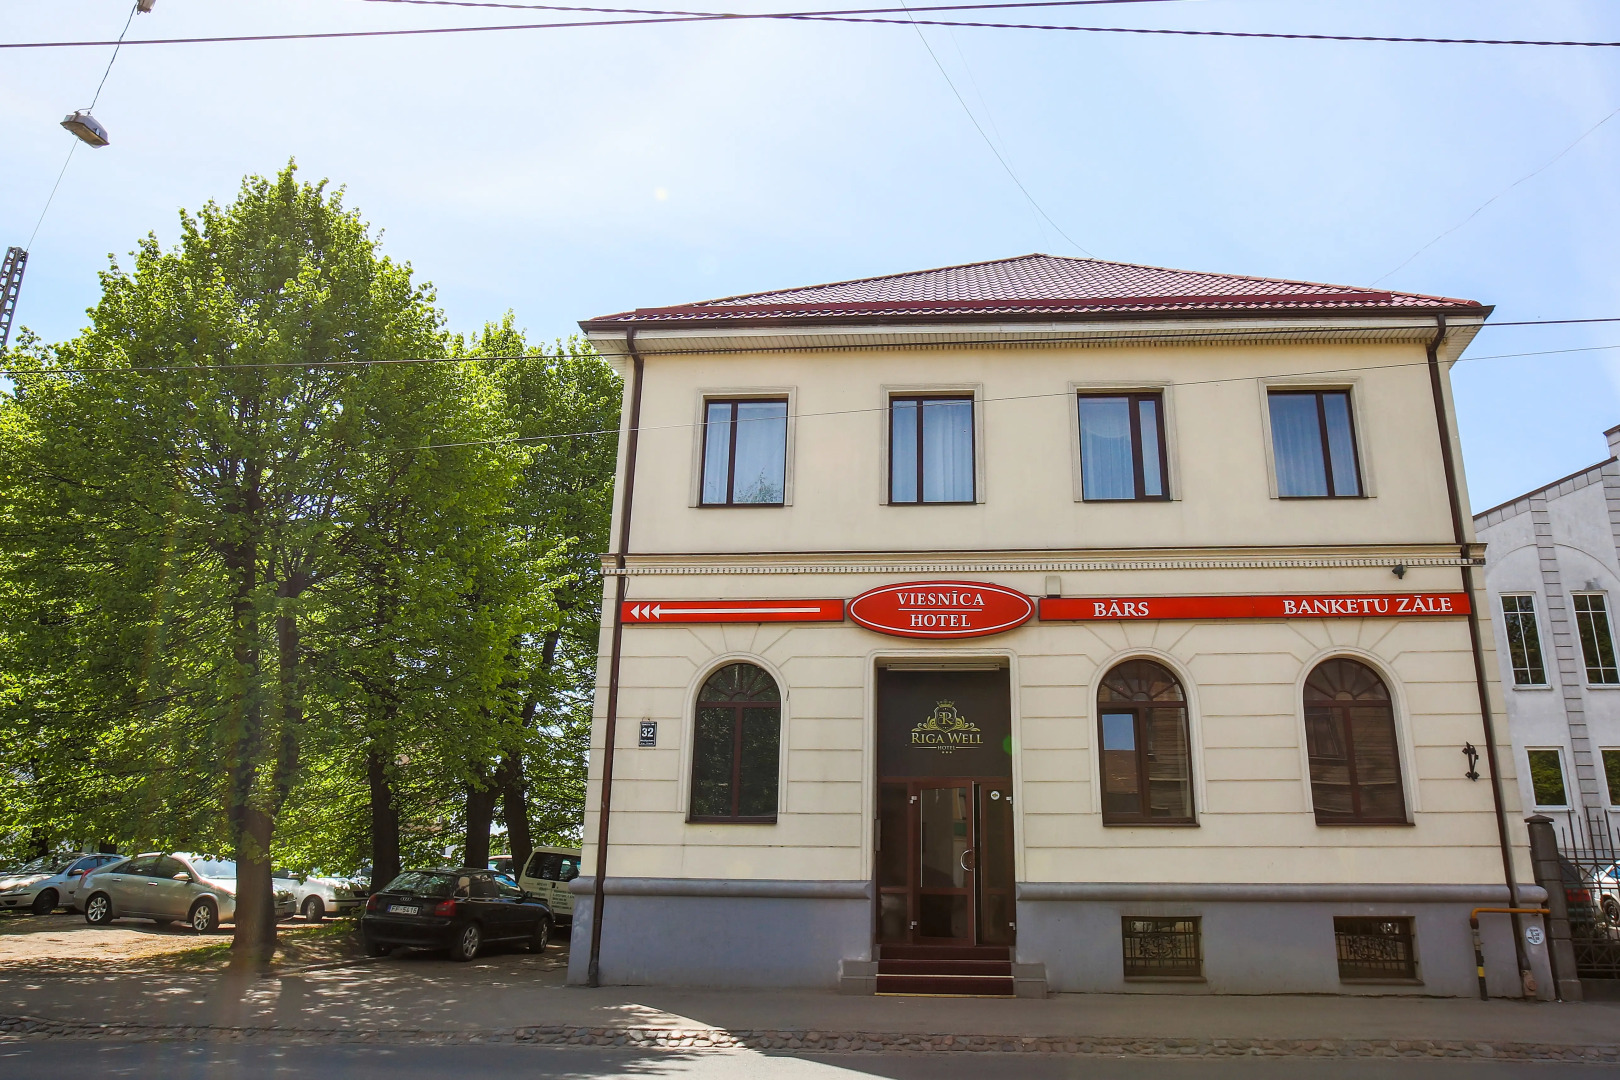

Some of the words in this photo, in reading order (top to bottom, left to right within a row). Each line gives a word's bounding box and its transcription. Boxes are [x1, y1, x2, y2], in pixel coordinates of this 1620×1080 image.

[896, 590, 985, 606] VIESNĪCA
[1283, 598, 1389, 615] BANKETU
[1396, 595, 1453, 613] ZĀLE
[1093, 599, 1149, 617] BĀRS
[910, 614, 971, 627] HOTEL
[642, 727, 654, 737] 32
